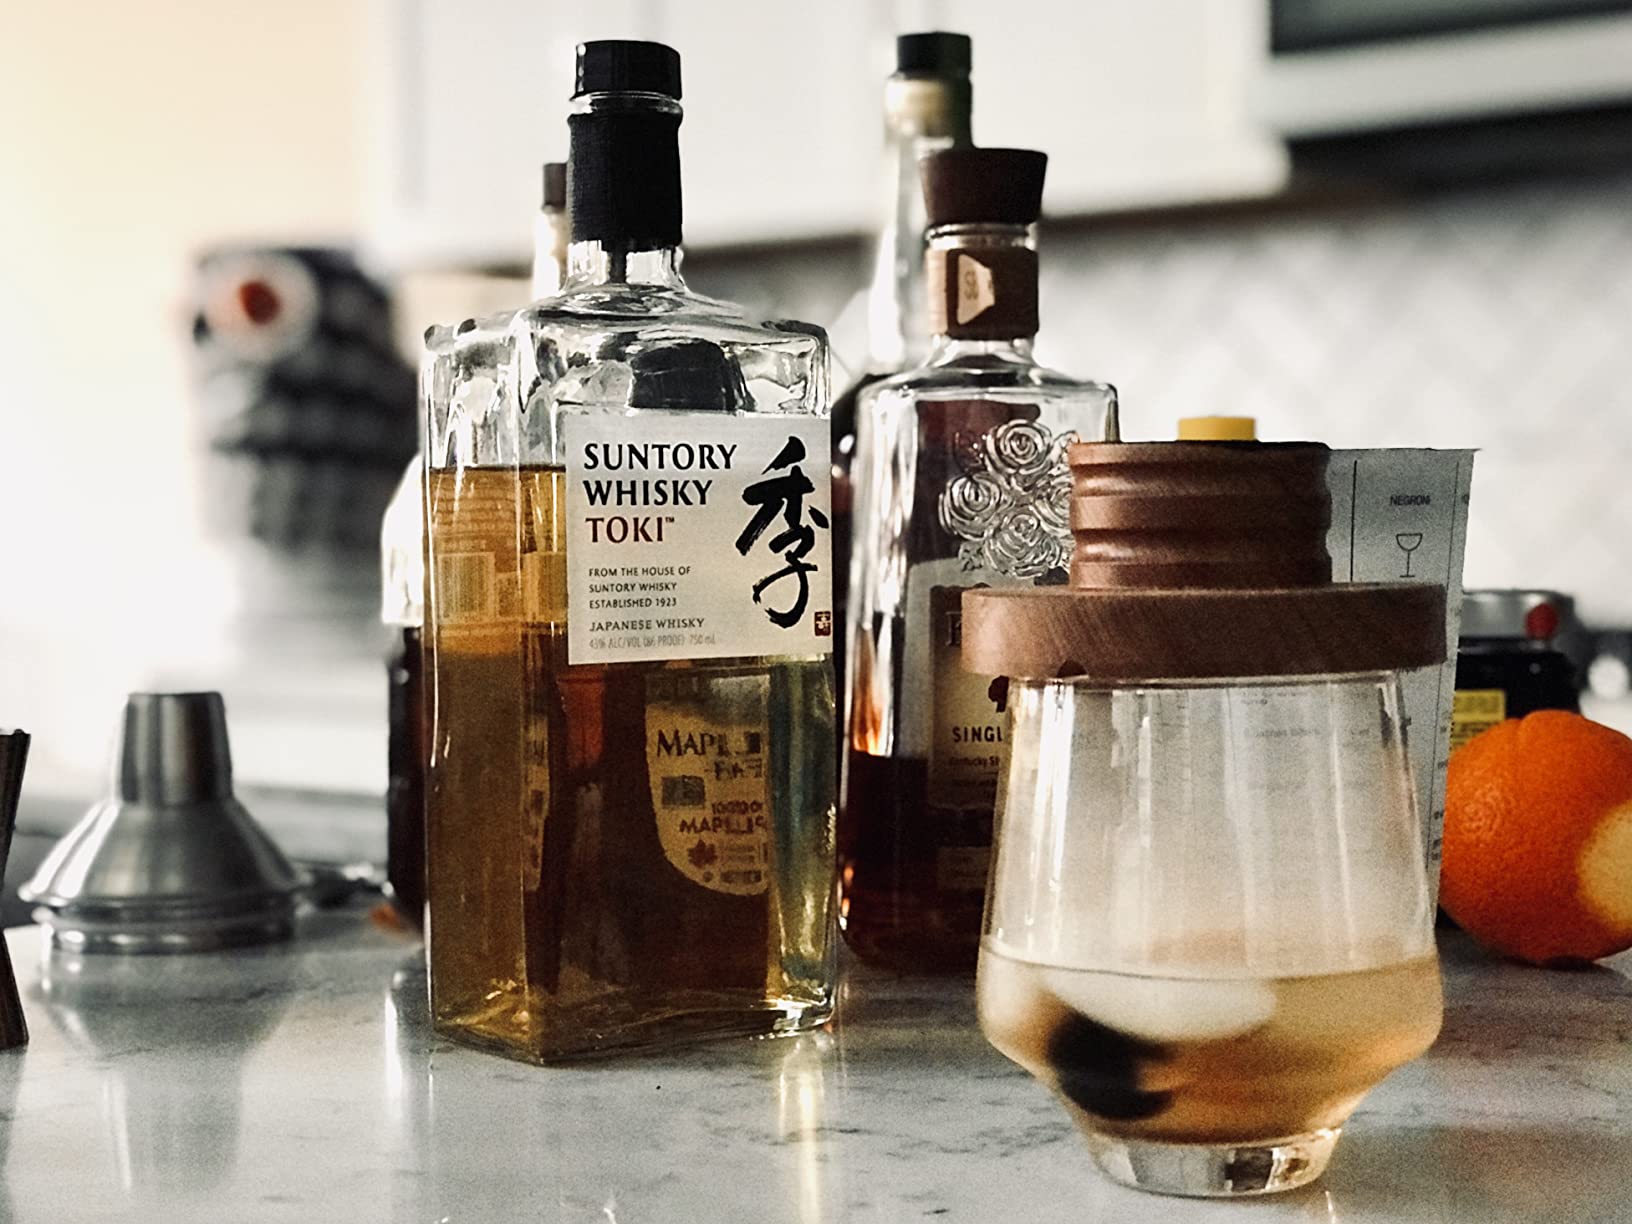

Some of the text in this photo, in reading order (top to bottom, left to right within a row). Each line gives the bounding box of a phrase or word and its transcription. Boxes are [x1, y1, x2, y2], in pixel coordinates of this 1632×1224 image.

[583, 443, 737, 470] SUNTORY
[583, 479, 713, 506] WHISKY
[735, 435, 829, 628] 季
[589, 566, 691, 577] FROM THE HOUSE OF
[589, 582, 677, 593] SUNTORY WHISKY
[589, 597, 677, 609] ESTABLISHED 1923
[589, 618, 705, 631] JAPANESE WHISKY
[952, 726, 1003, 743] SINGL
